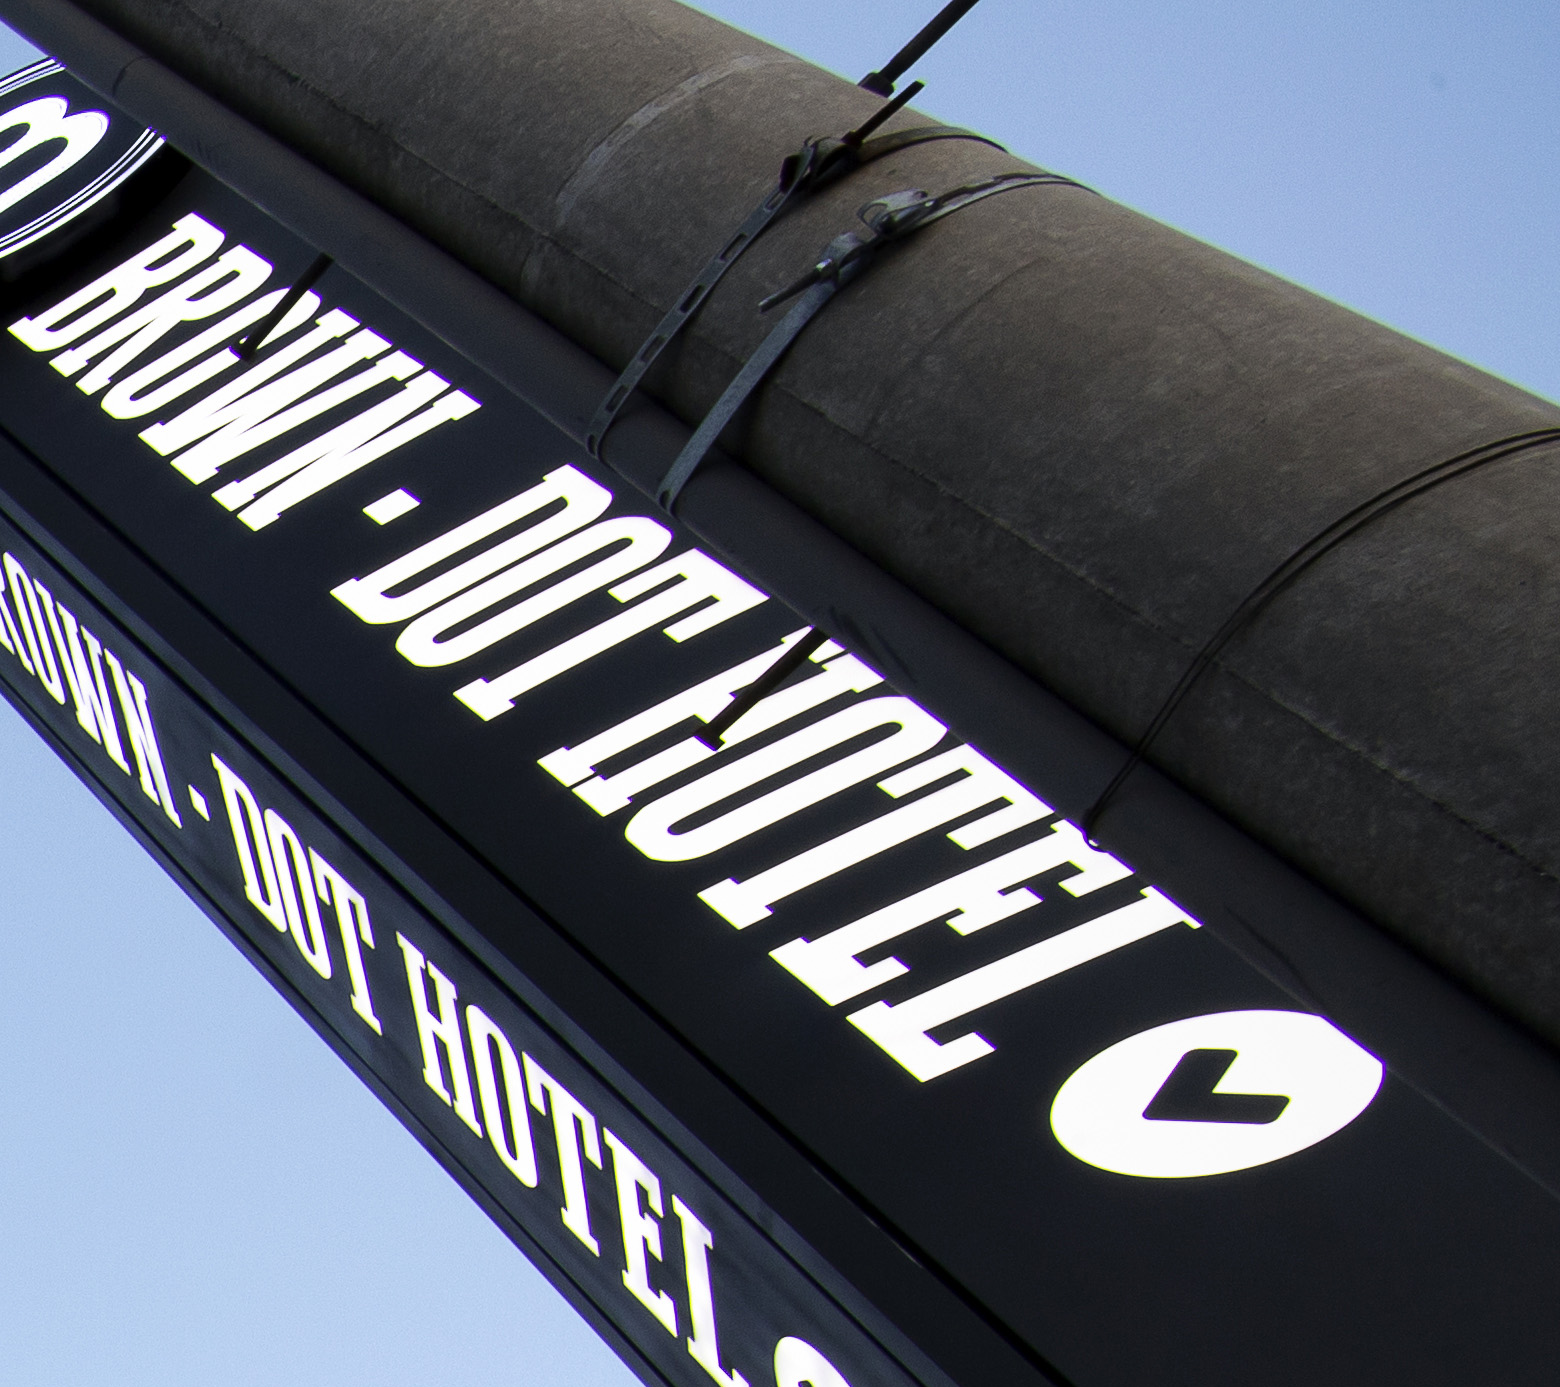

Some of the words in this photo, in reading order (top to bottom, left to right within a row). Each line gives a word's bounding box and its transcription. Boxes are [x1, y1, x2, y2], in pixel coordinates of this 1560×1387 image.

[7, 211, 482, 532] BROWN
[330, 463, 770, 722] DOT
[210, 752, 383, 1036] DOT
[537, 624, 1204, 1083] HOTEL
